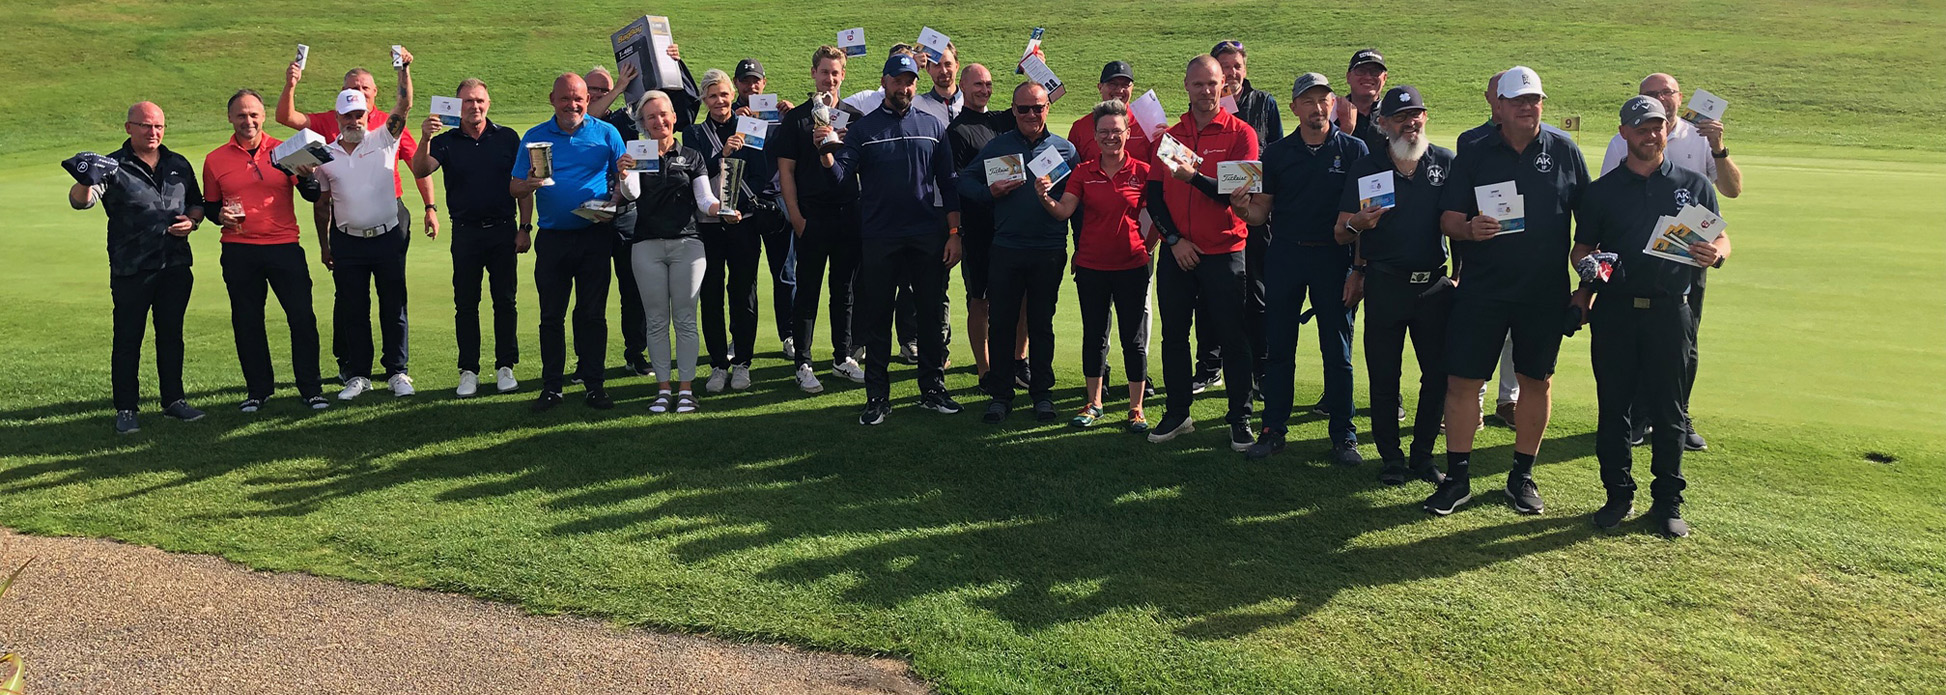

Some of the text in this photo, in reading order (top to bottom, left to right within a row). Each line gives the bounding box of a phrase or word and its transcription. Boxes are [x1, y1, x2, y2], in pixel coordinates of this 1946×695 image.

[1565, 118, 1573, 129] 9
[1536, 157, 1551, 165] AK
[1221, 173, 1248, 182] Titleist
[1428, 169, 1443, 178] AK
